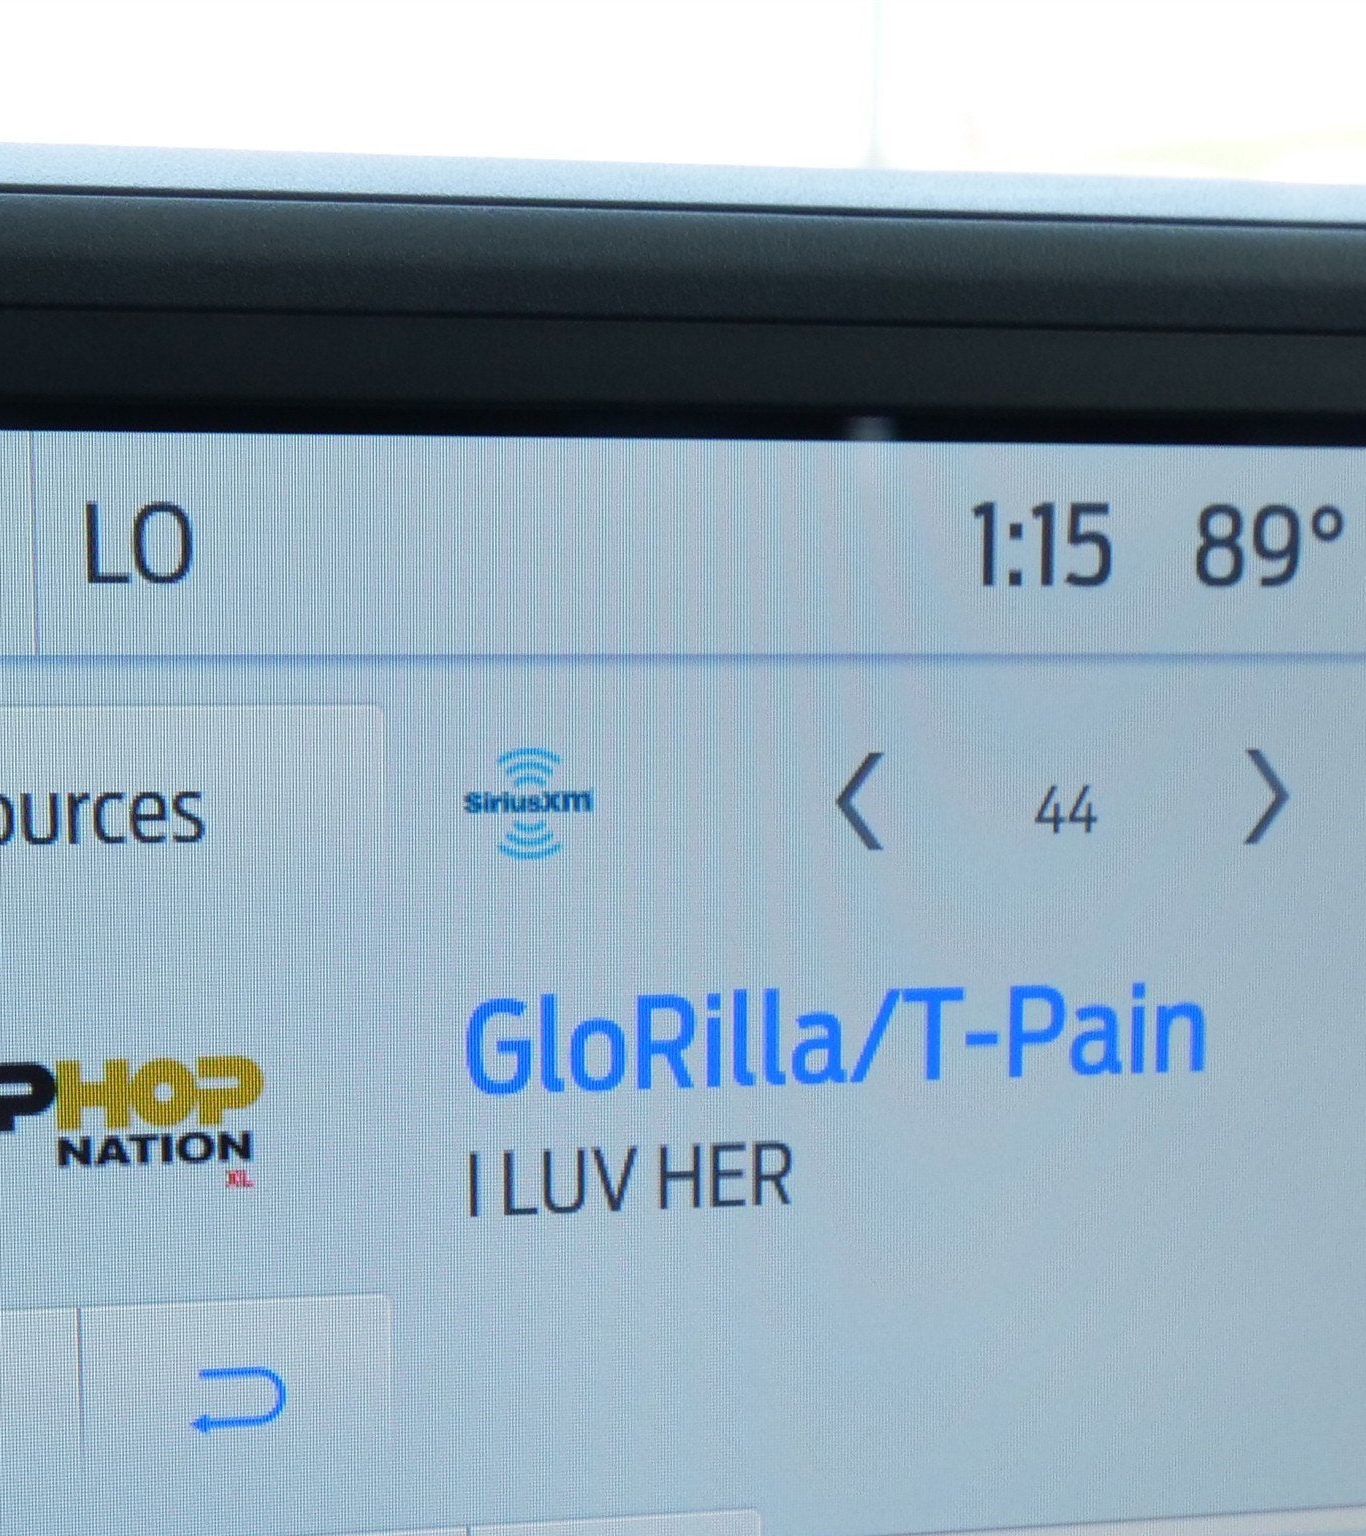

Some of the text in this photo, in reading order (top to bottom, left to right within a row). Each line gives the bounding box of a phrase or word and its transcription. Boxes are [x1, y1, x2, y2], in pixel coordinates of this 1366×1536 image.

[84, 500, 194, 586] LO
[972, 501, 1113, 589] 1:15
[1194, 502, 1345, 589] 89°
[1034, 784, 1098, 834] 44
[465, 981, 1207, 1097] GloRilla/T-Pain
[57, 1131, 255, 1168] NATION
[467, 1140, 794, 1218] I LUV HER
